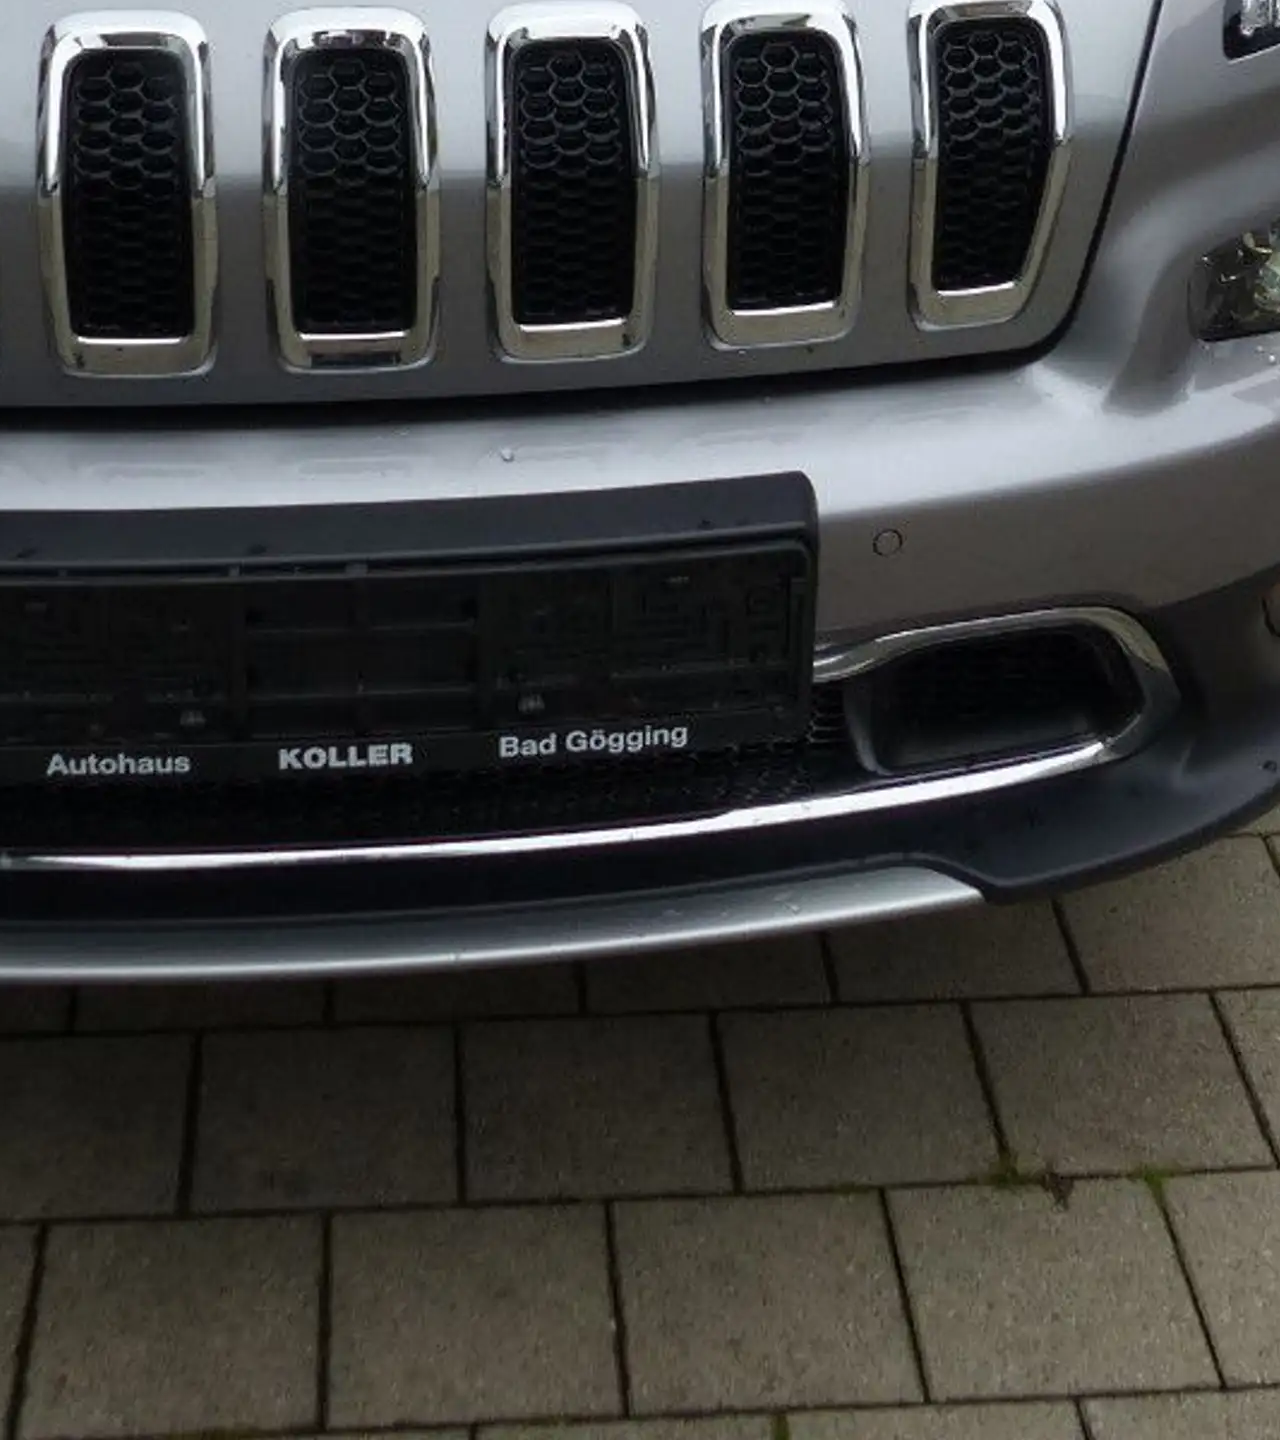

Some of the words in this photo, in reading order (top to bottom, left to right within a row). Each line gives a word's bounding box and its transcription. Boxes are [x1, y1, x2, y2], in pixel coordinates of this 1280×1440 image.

[46, 753, 191, 777] Autohaus
[278, 742, 414, 770] KOLLER
[499, 733, 557, 758] Bad
[566, 724, 688, 753] Gögging
